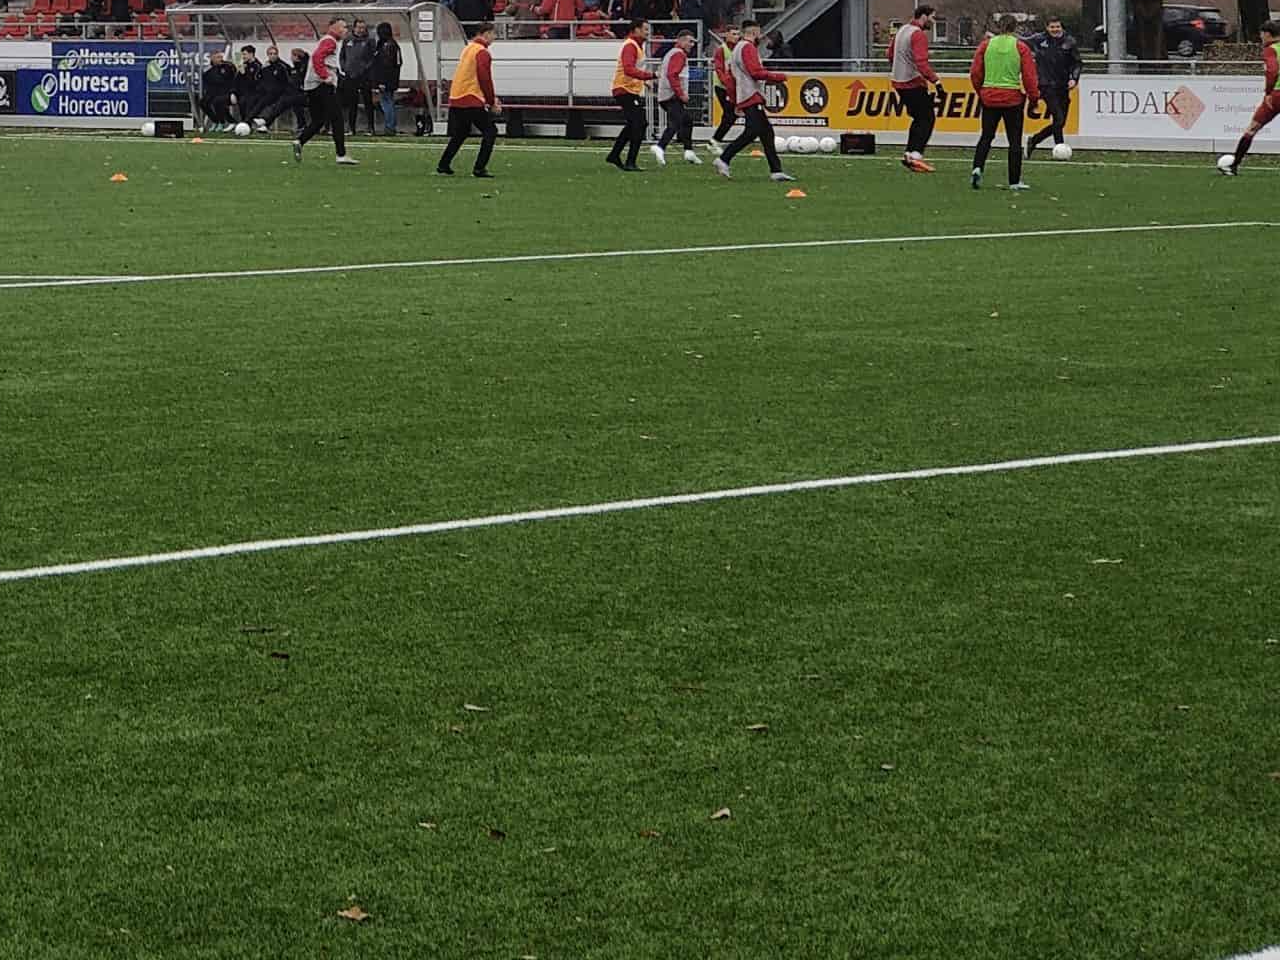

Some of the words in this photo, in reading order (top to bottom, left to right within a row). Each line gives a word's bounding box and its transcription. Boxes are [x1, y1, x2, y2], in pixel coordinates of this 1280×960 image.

[79, 48, 135, 65] Horesca
[58, 72, 129, 92] Horesca
[58, 97, 129, 115] Horecavo
[1090, 90, 1182, 114] TIDAK
